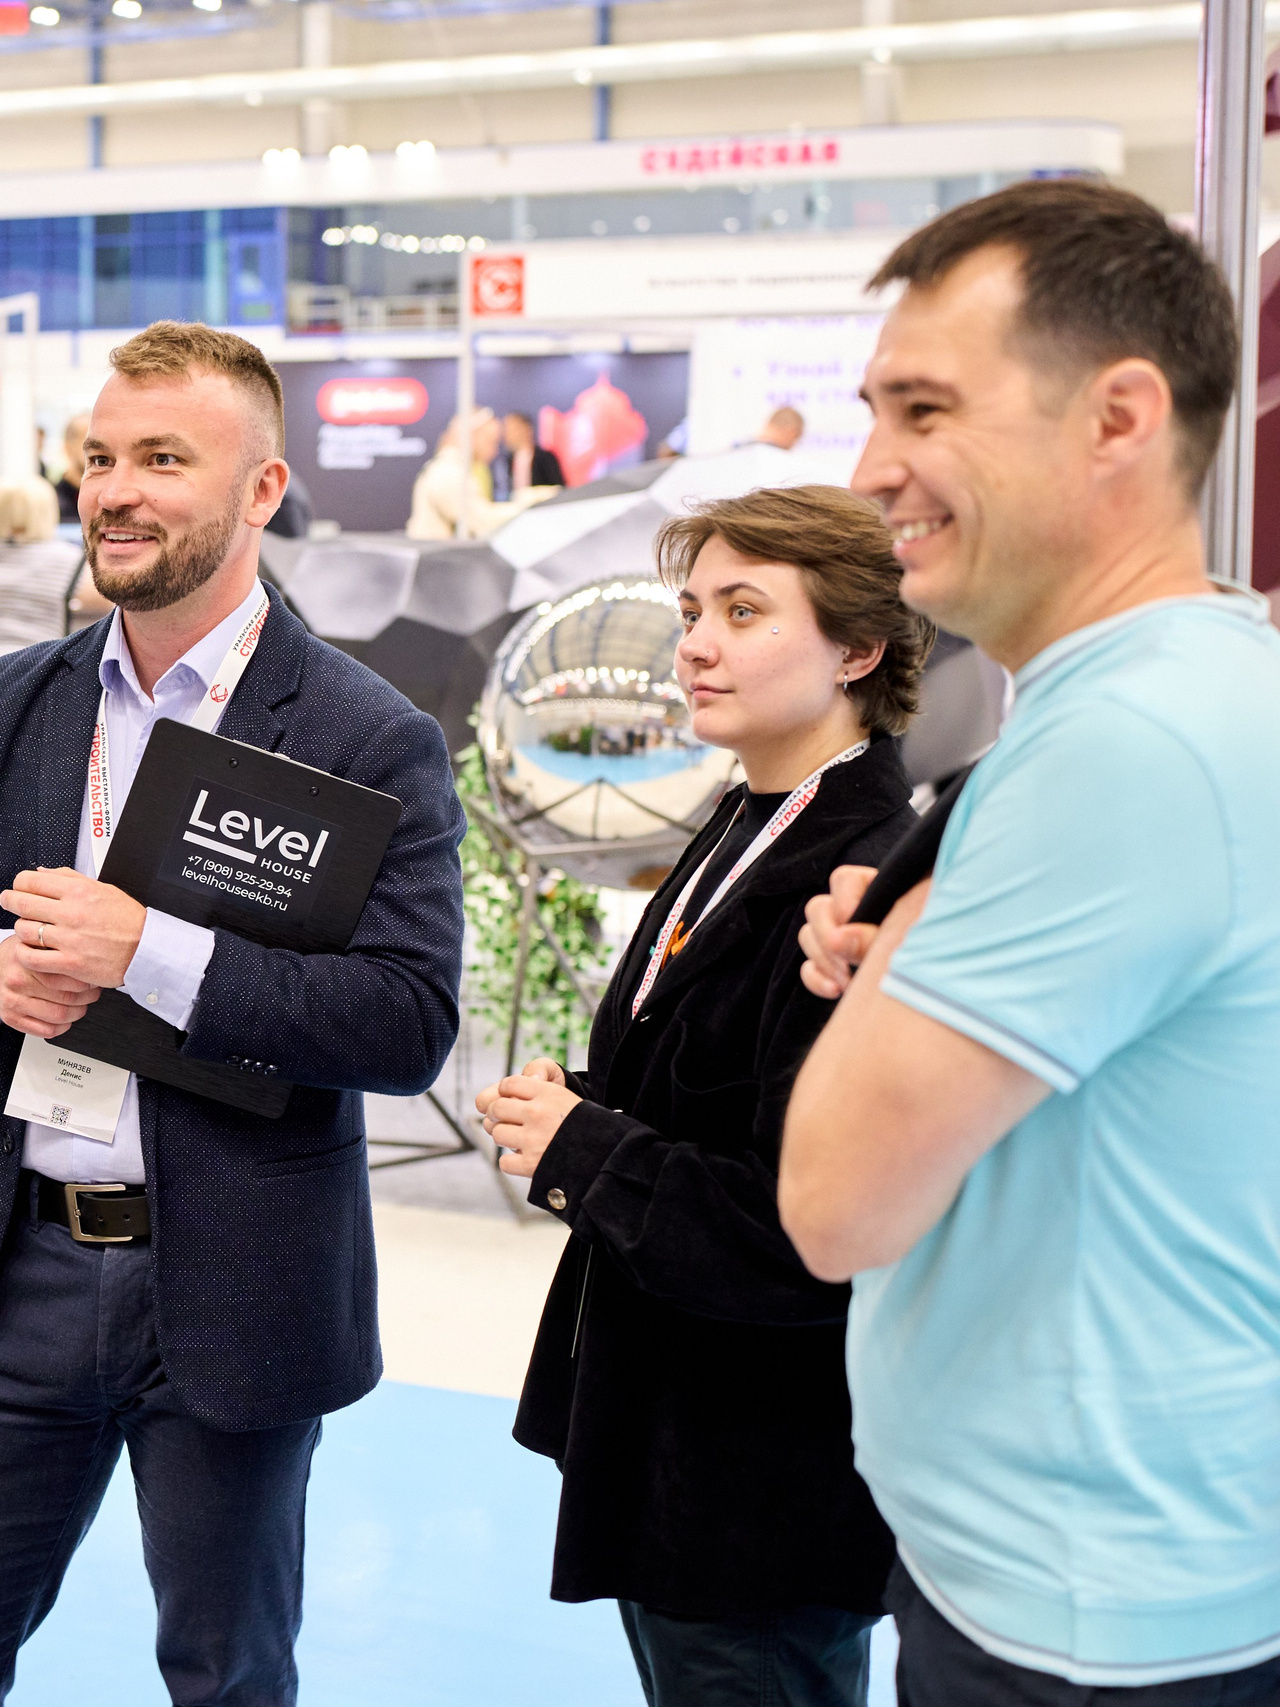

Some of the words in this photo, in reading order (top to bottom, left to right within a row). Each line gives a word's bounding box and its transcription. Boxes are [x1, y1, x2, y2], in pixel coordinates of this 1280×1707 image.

[233, 619, 254, 651] УРАЛЬСКАЯ
[101, 766, 111, 838] ВЫСТАВКА-ФОРУМ
[767, 790, 801, 830] УРАЛЬСКАЯ
[189, 789, 330, 868] Level
[181, 866, 288, 912] levelhouseekb.ru
[187, 855, 203, 866] +7
[203, 859, 233, 879] (908)
[234, 871, 292, 898] 925-29-94
[260, 858, 313, 884] HOUSE
[632, 903, 681, 1015] СТРОИТЕЛЬСТВ
[54, 1075, 68, 1085] Level
[68, 1079, 84, 1089] House
[57, 1058, 92, 1074] МИНЯЗЕВ
[60, 1068, 82, 1081] Денис
